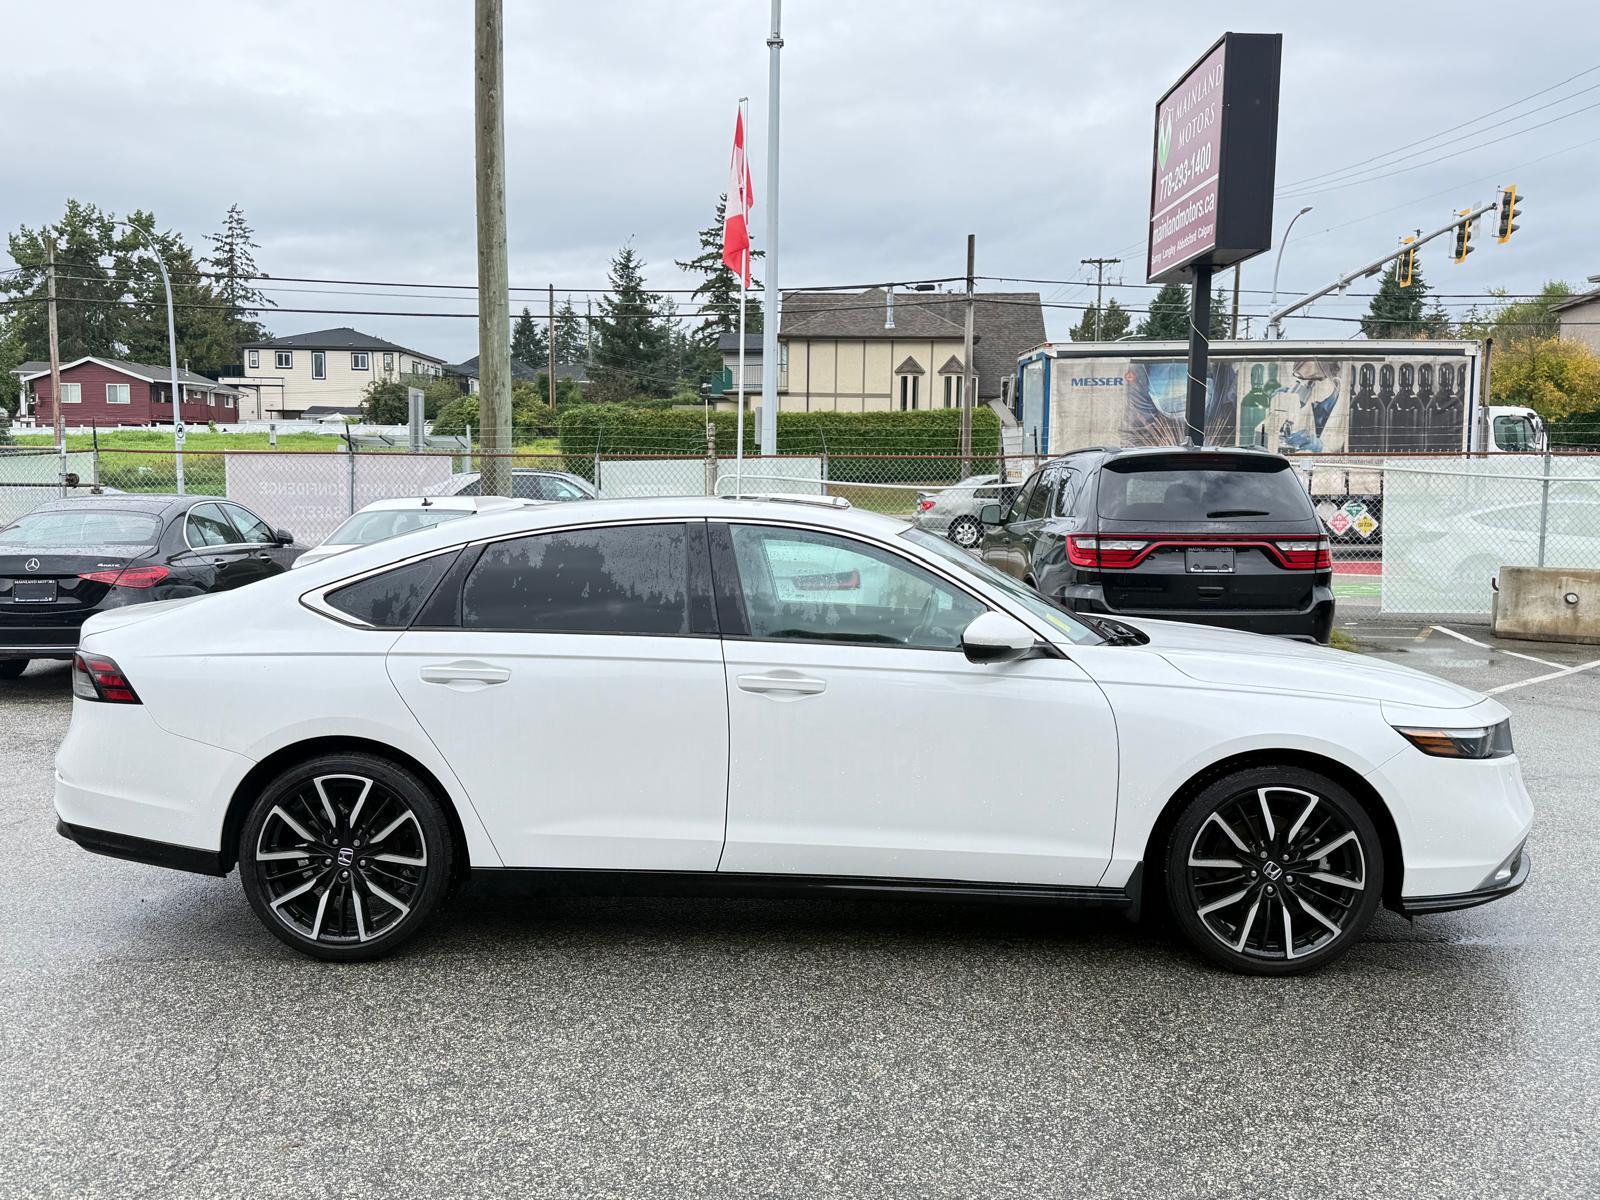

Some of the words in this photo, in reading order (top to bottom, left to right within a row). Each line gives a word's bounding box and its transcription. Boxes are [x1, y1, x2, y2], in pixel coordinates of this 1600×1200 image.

[1175, 63, 1223, 122] MAINLAND
[1178, 102, 1216, 149] MOTORS
[1159, 141, 1212, 203] 778-293-1400
[1153, 192, 1215, 246] mainlandmotors.ca
[1197, 223, 1214, 239] Calgary
[1071, 377, 1123, 387] MESSER
